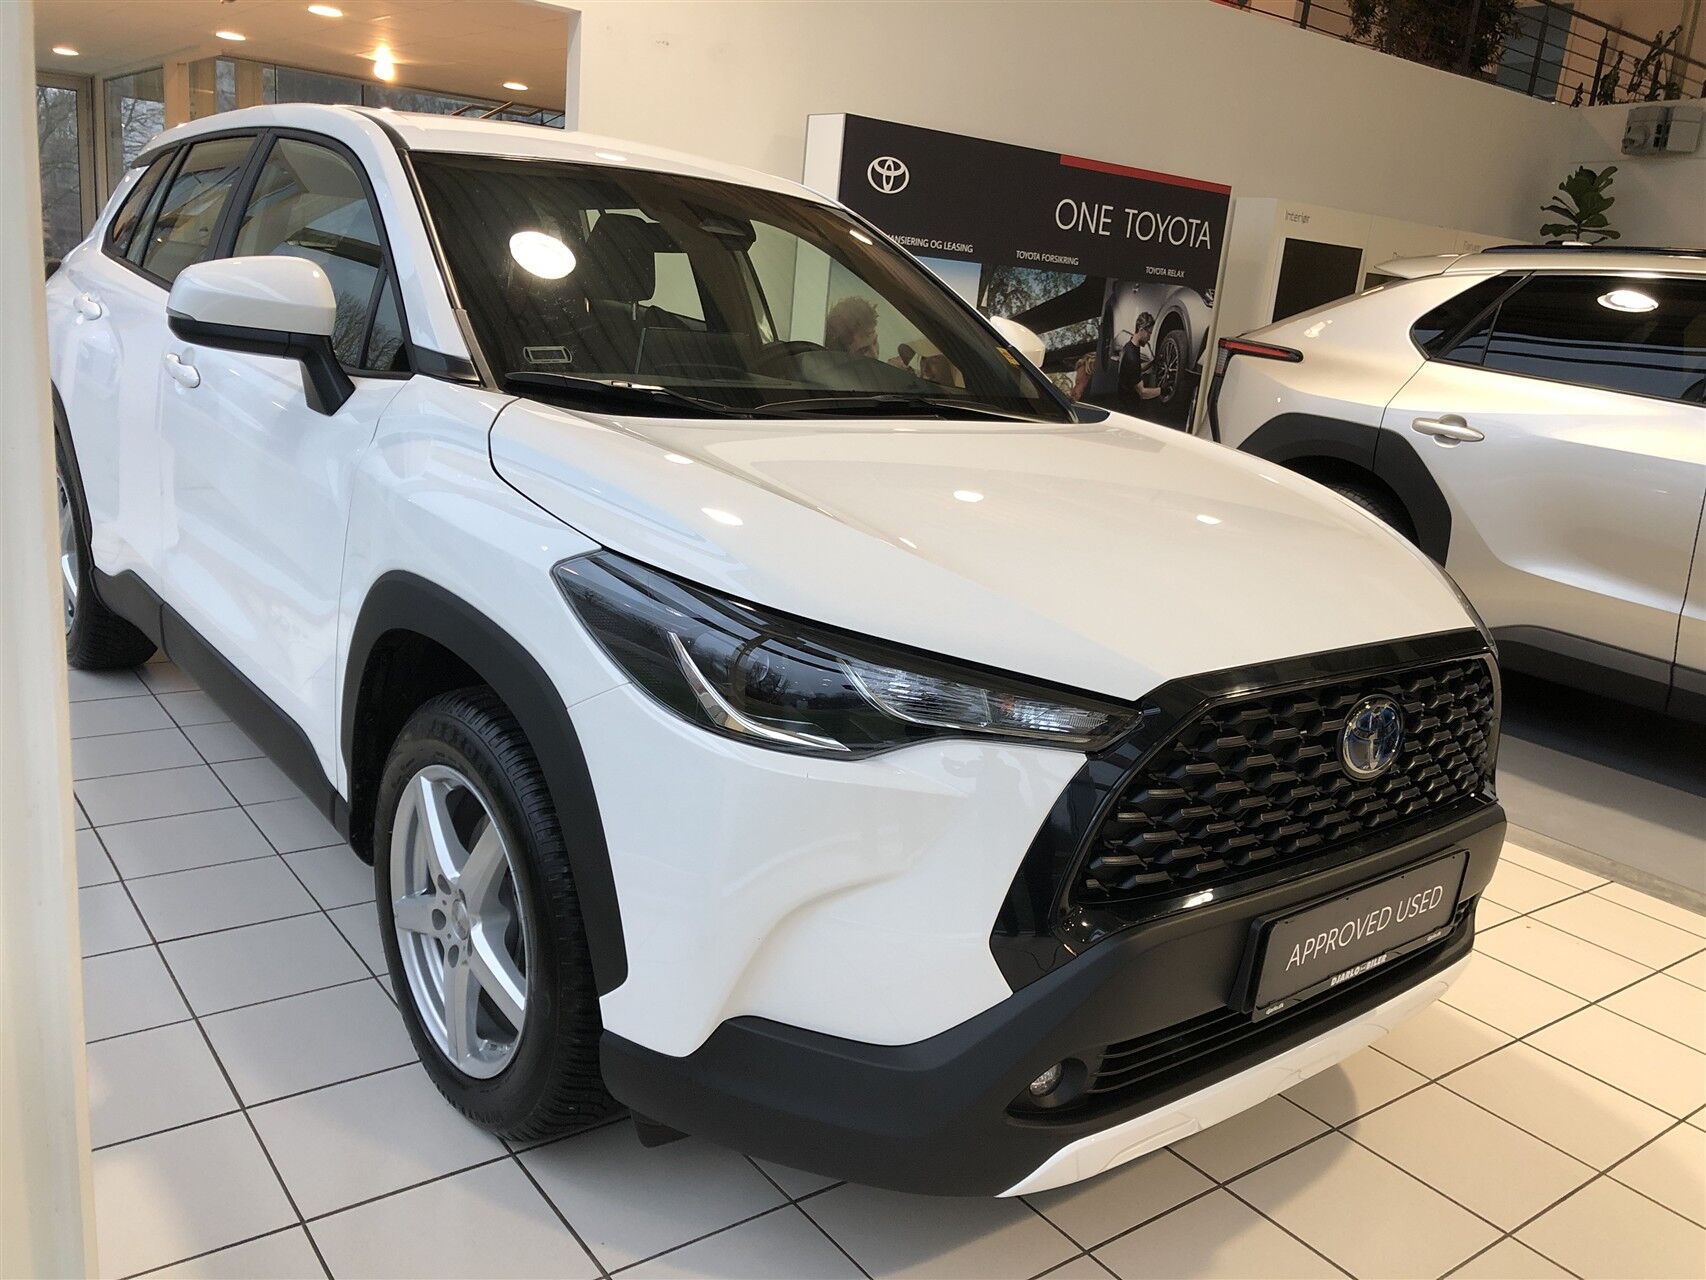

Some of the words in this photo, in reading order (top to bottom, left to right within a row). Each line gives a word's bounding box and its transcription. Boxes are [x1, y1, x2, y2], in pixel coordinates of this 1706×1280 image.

[1055, 198, 1114, 236] ONE
[1124, 207, 1211, 250] TOYOTA
[888, 233, 929, 248] ANSIERING
[930, 239, 943, 250] OG
[943, 241, 974, 253] LEASING
[1016, 250, 1041, 262] TOYOTA
[1041, 253, 1079, 266] FORSIKRING
[1145, 265, 1167, 276] TOYOTA
[1167, 267, 1185, 278] RELAX
[1285, 905, 1392, 971] APPROVED
[1396, 885, 1444, 923] USED
